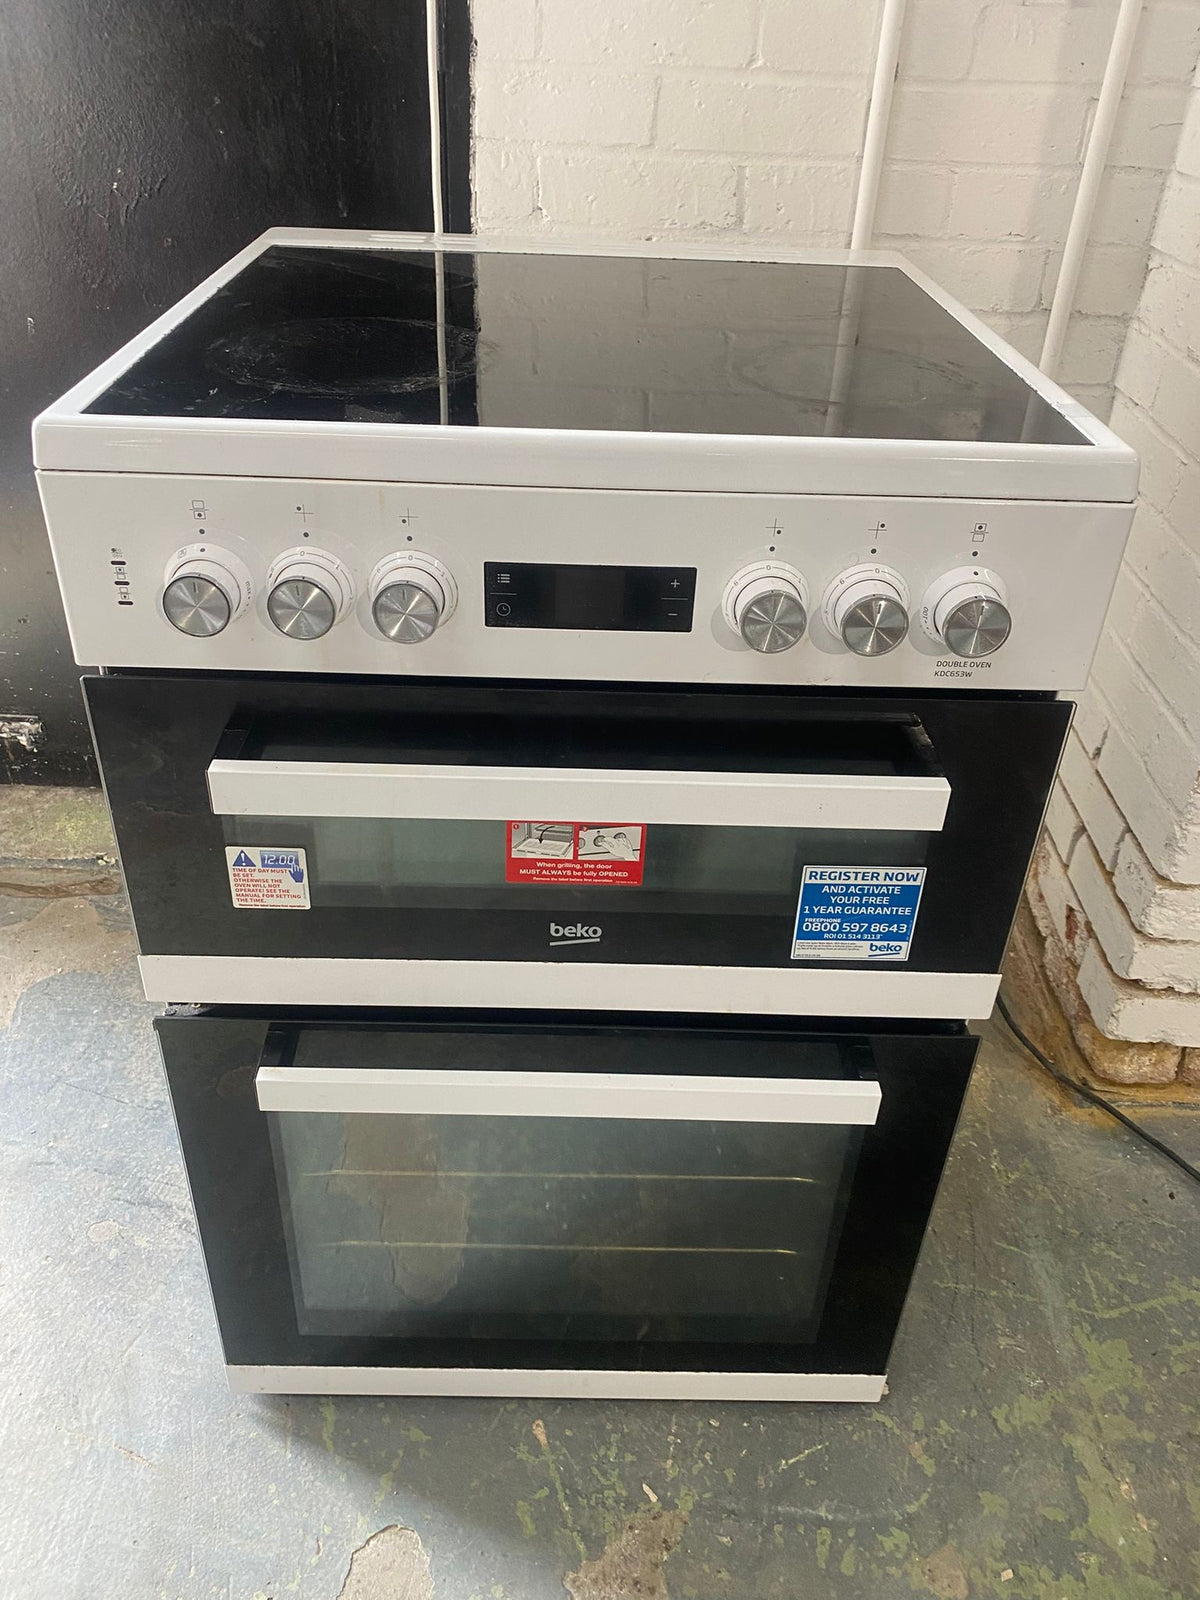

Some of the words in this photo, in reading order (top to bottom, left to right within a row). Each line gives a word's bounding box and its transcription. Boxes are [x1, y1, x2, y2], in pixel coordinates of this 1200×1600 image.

[936, 660, 968, 668] DOUBLE
[934, 670, 973, 678] KDC653W
[264, 854, 295, 865] 12.00
[809, 870, 880, 881] REGISTER
[883, 872, 920, 882] NOW
[822, 885, 846, 893] AND
[848, 886, 902, 894] ACTIVATE
[830, 896, 860, 904] YOUR
[862, 896, 890, 905] FREE
[813, 906, 842, 914] YEAR
[844, 906, 912, 915] GUARANTEE
[550, 922, 602, 938] beko
[802, 922, 839, 932] 0800
[842, 923, 868, 932] 597
[870, 923, 907, 933] 8643
[869, 943, 903, 952] beko
